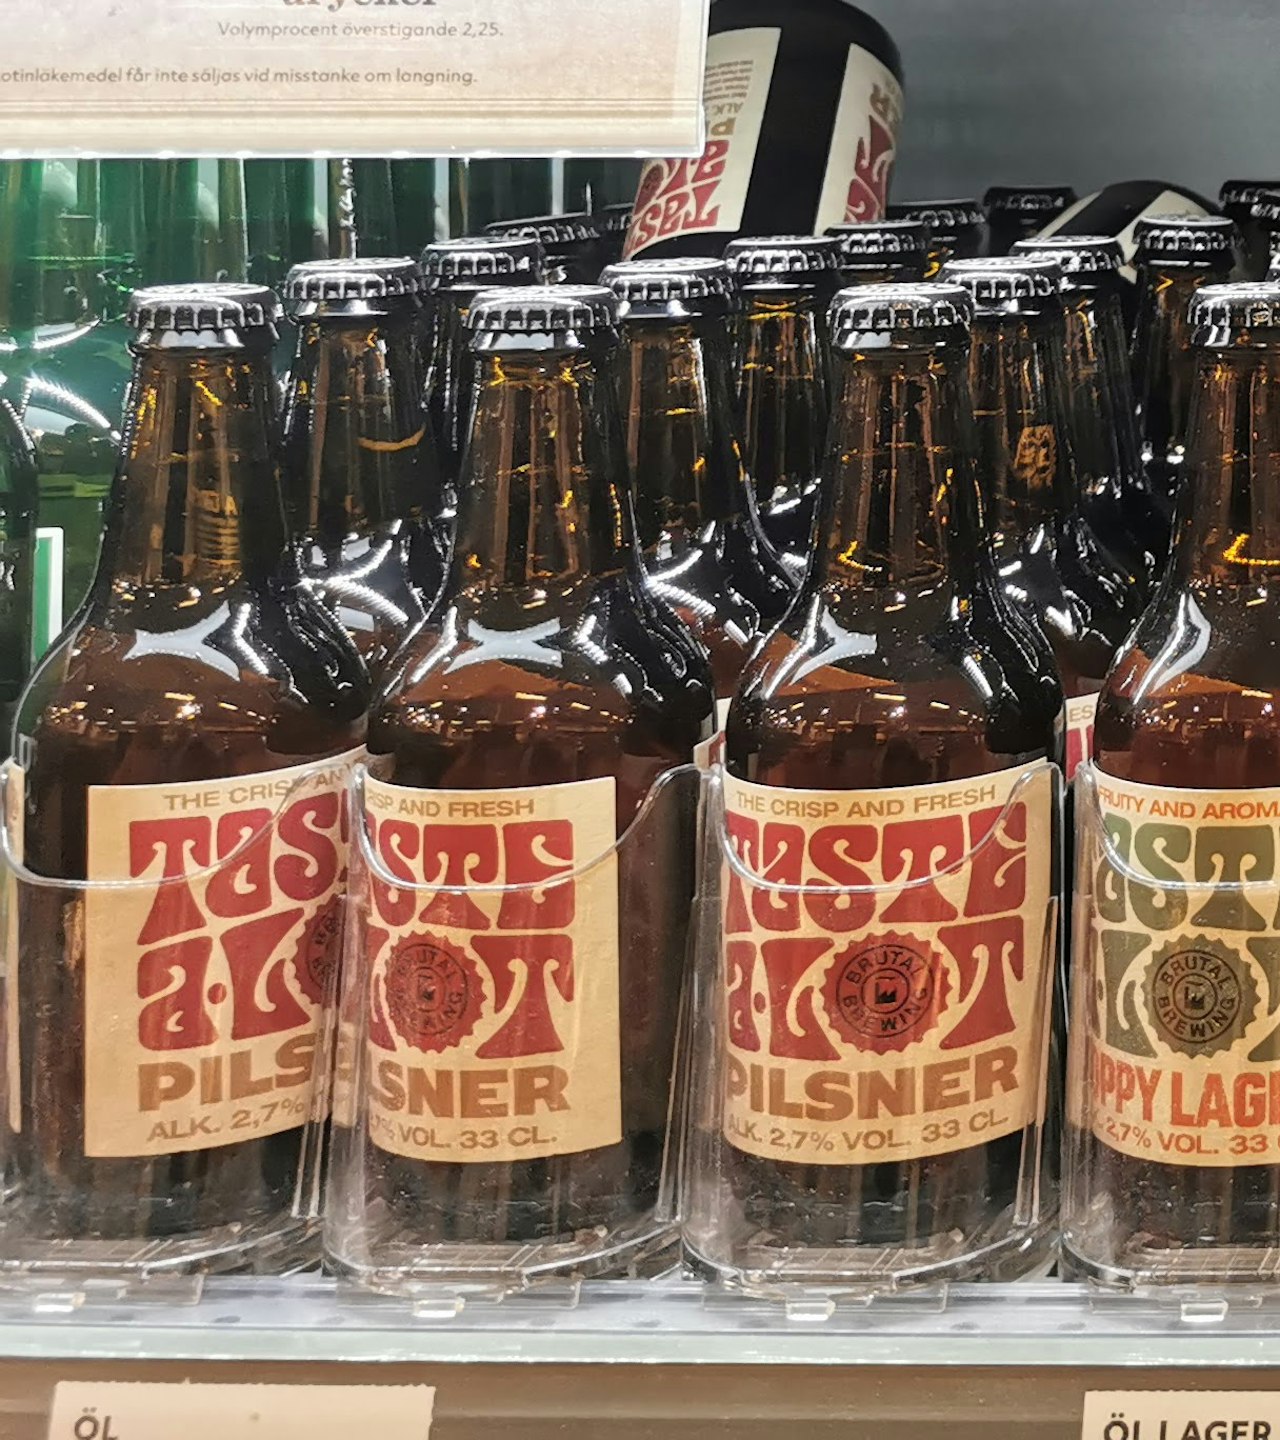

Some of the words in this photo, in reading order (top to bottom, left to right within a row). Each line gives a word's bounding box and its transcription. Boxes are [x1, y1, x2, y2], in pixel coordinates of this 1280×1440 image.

[217, 21, 338, 39] Volymprocent
[343, 20, 457, 40] överstigande
[461, 21, 505, 39] 2,25.
[126, 67, 151, 83] får
[155, 68, 188, 83] inte
[191, 68, 240, 87] säljas
[245, 68, 270, 83] vid
[273, 68, 360, 83] misstanke
[365, 71, 391, 83] om
[396, 68, 478, 87] langning.
[165, 790, 220, 811] THE
[398, 797, 441, 817] AND
[448, 799, 534, 816] FRESH
[736, 790, 766, 812] THE
[770, 798, 840, 818] CRISP
[847, 798, 904, 818] AND
[913, 784, 997, 814] FRESH
[1148, 799, 1195, 818] AND
[1156, 994, 1237, 1039] BREWING
[725, 1045, 1019, 1121] PILSNER
[145, 1116, 222, 1142] ALK.
[230, 1098, 305, 1130] 2,7%
[769, 1127, 835, 1151] 2,7%
[841, 1129, 909, 1150] VOL.
[921, 1123, 960, 1144] 33
[968, 1108, 1009, 1131] CL.
[400, 1126, 451, 1148] VOL.
[459, 1130, 498, 1149] 33
[507, 1127, 557, 1147] CL.
[1105, 1114, 1153, 1149] 2,7%
[1157, 1129, 1218, 1155] VOL.
[1229, 1132, 1269, 1153] 33
[1160, 1421, 1272, 1440] LAGER
